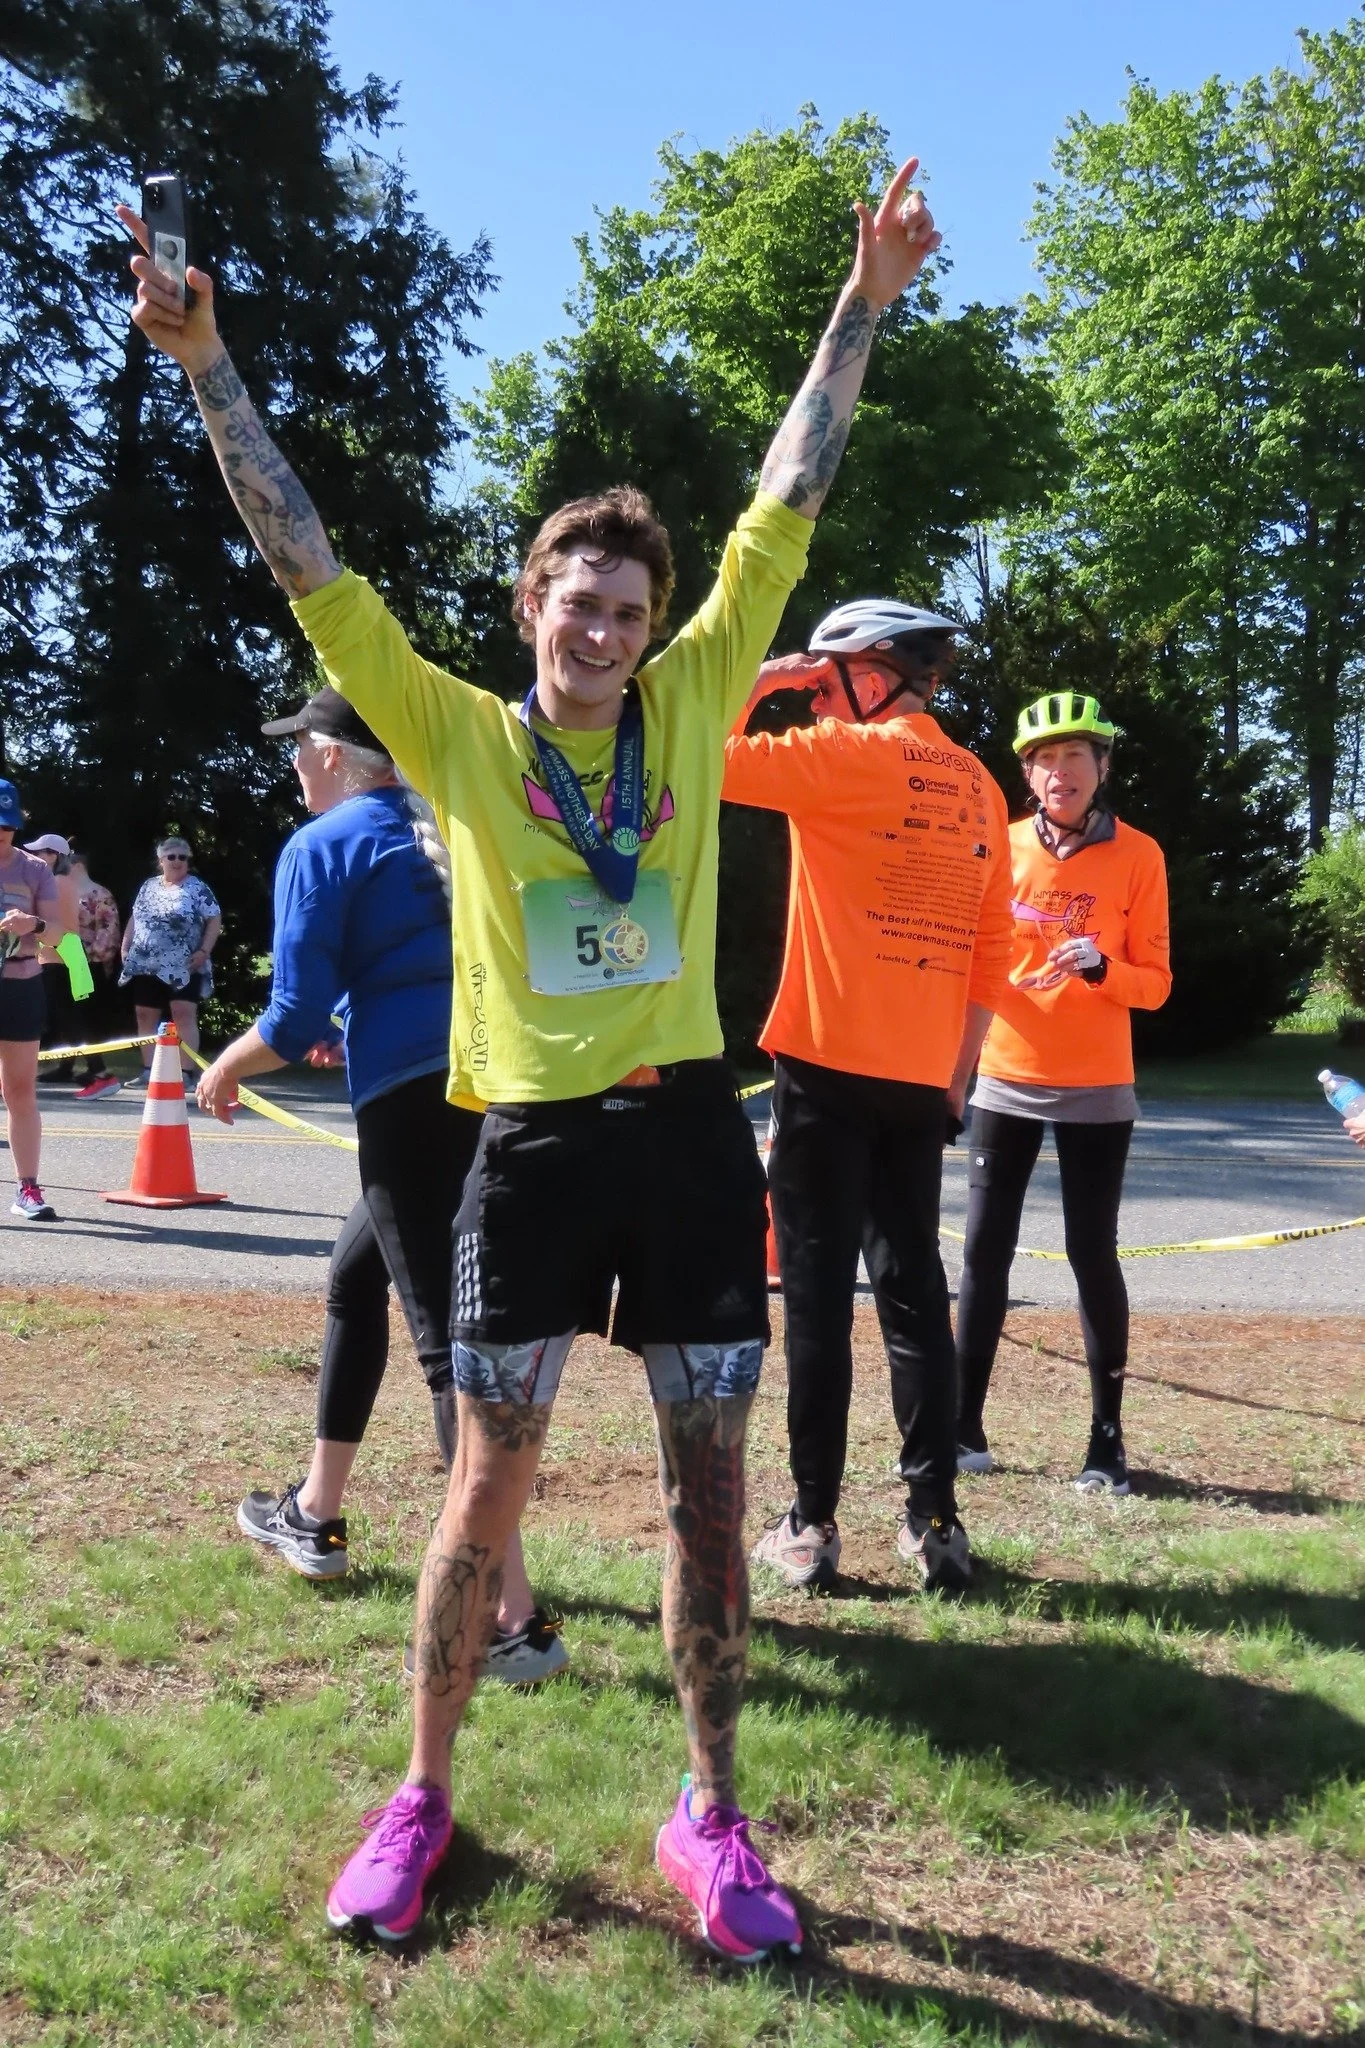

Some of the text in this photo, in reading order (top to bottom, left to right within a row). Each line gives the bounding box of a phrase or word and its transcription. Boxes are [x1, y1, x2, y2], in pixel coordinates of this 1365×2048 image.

[621, 737, 634, 809] 15TH ANNUAL
[925, 779, 959, 791] Greenfield
[546, 749, 570, 781] WMASS
[584, 831, 600, 851] DAY
[1033, 890, 1072, 900] WMASS
[866, 910, 885, 922] The
[888, 915, 910, 925] Best
[925, 919, 932, 928] in
[934, 921, 966, 936] Western
[576, 924, 603, 967] 5
[901, 957, 911, 965] for
